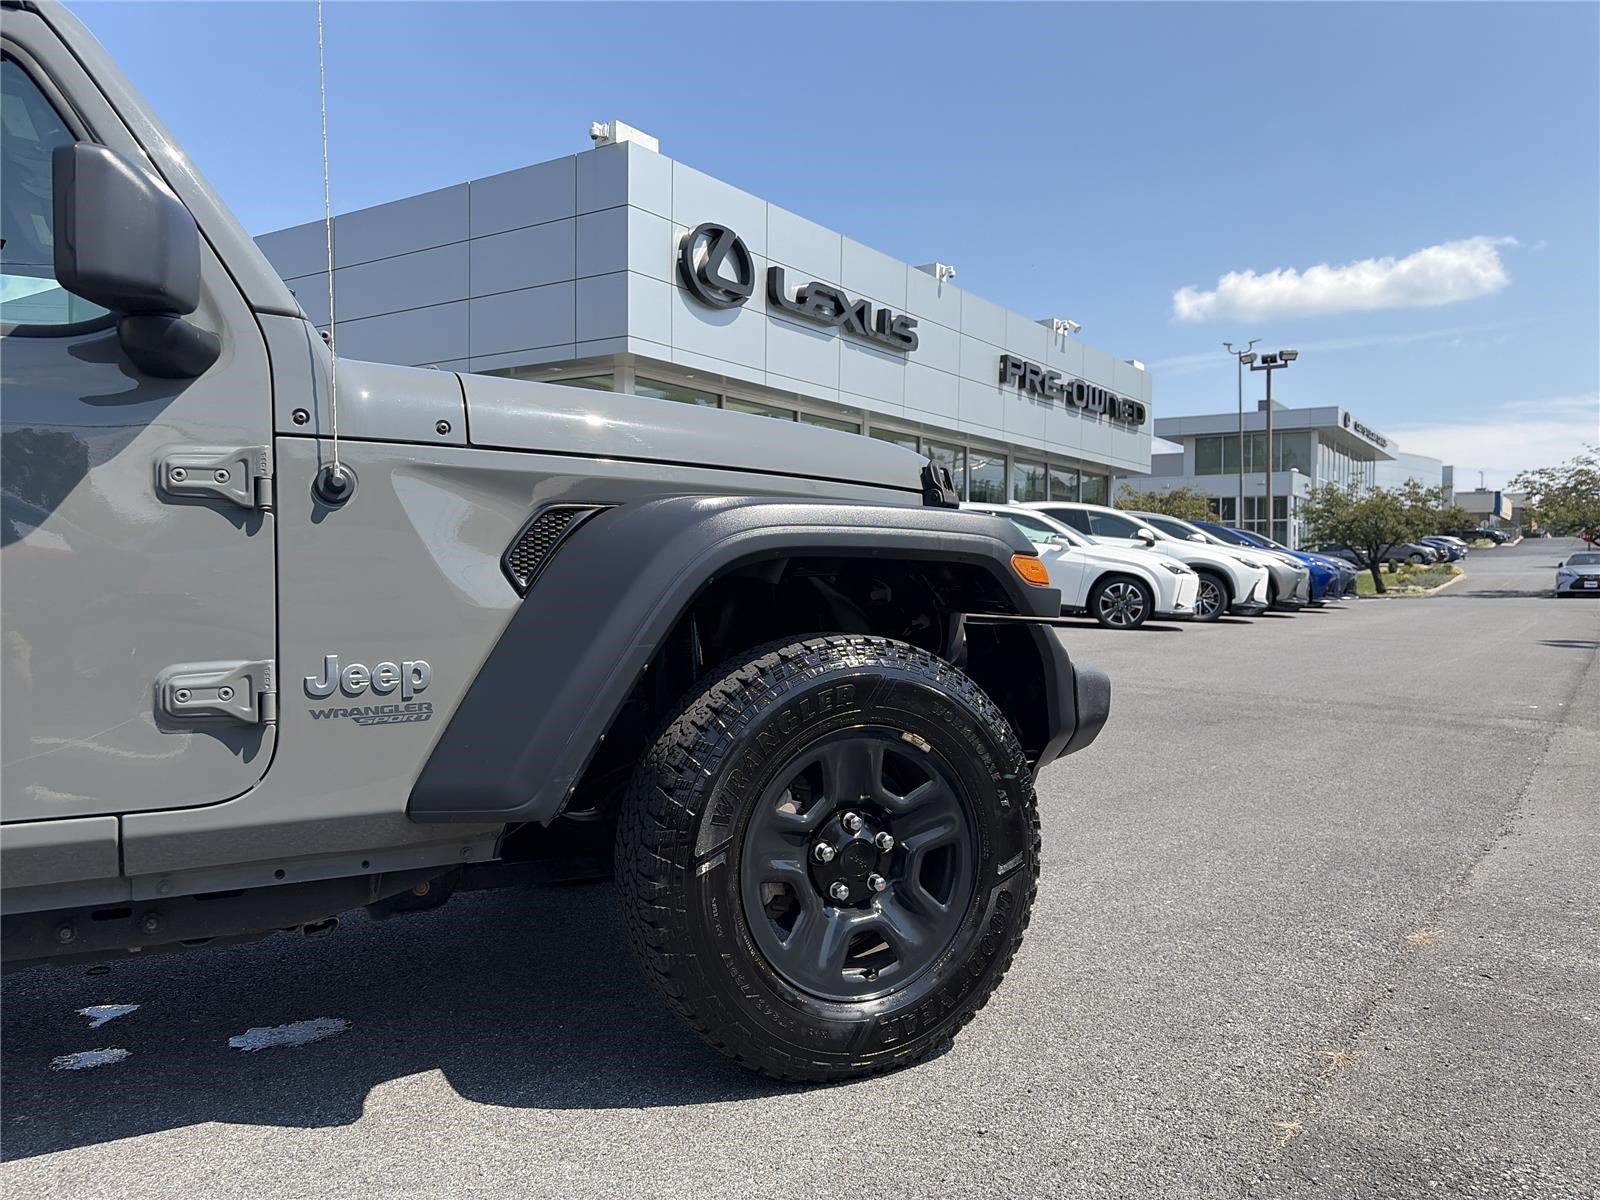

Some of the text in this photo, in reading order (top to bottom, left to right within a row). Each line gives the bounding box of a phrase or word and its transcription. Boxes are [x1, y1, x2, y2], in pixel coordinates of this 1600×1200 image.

[767, 266, 919, 351] LEXUS
[999, 354, 1146, 425] PRE-OWNED
[304, 654, 432, 701] Jeep
[308, 702, 433, 720] WRANGLER
[355, 713, 432, 726] SPORT
[708, 684, 857, 828] WRANGLER
